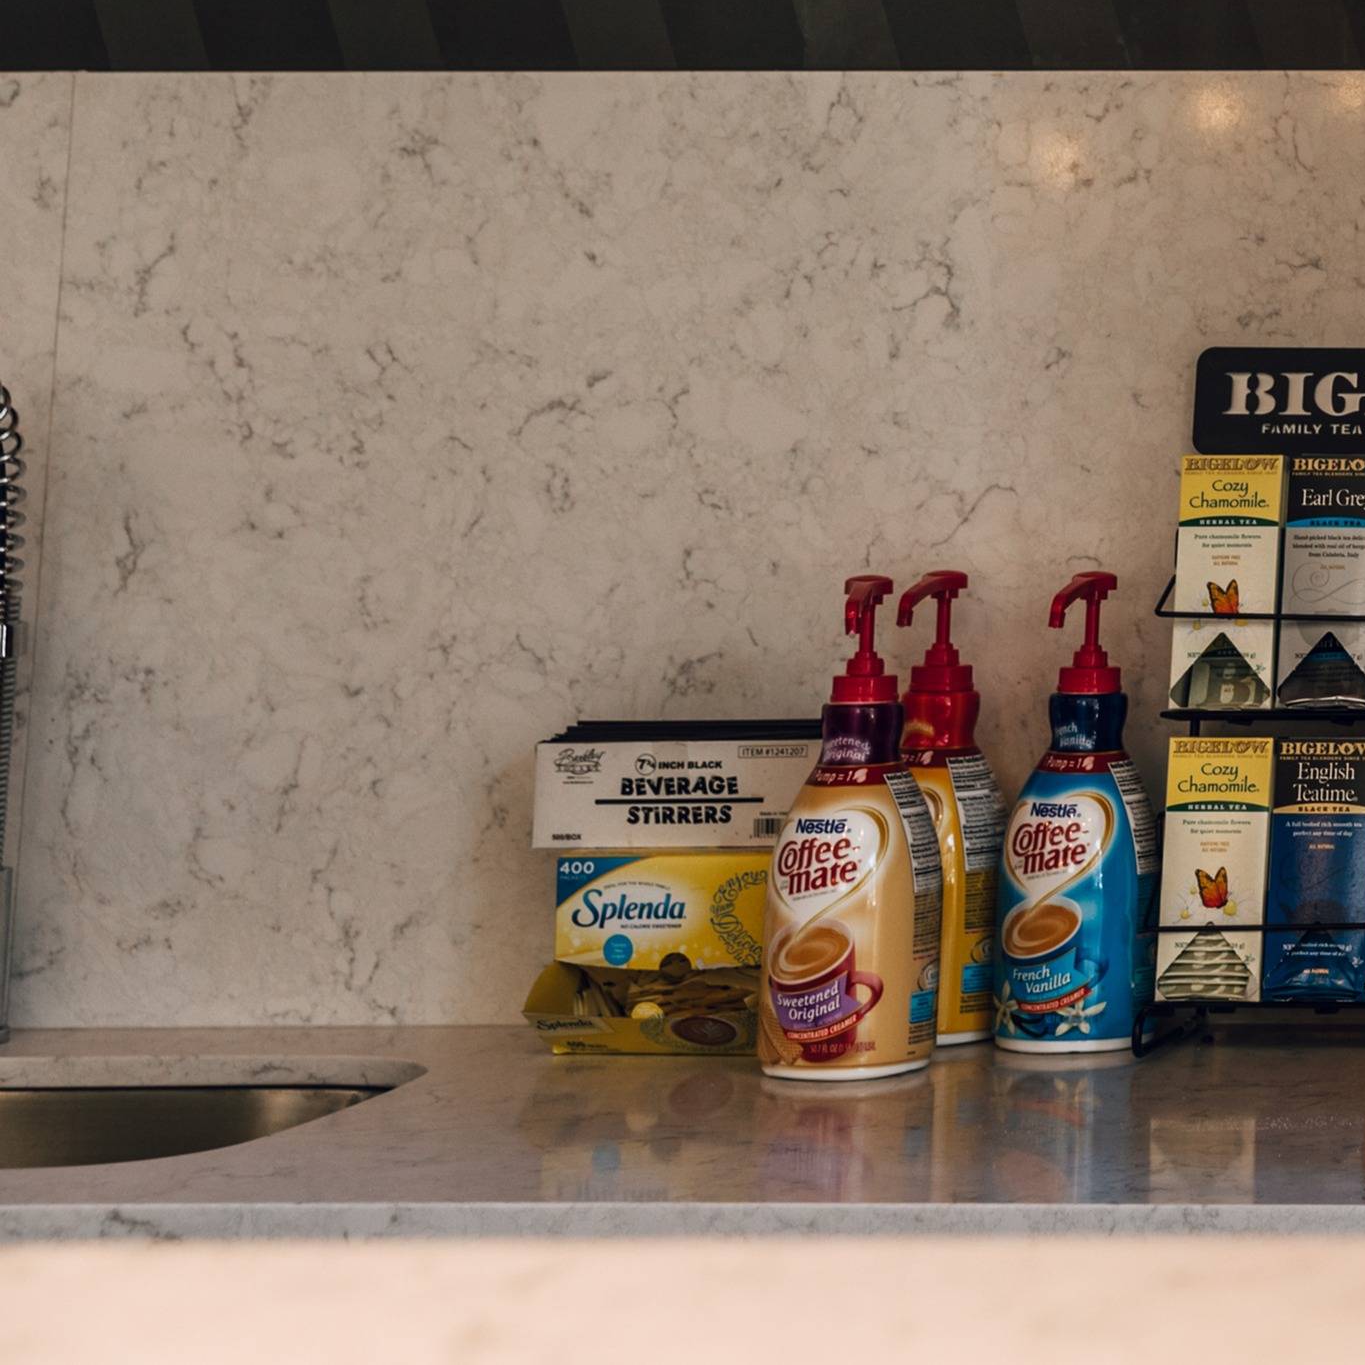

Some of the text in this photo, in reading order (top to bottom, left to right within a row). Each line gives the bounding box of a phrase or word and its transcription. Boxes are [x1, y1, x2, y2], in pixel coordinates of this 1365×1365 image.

[1261, 423, 1322, 434] FAMILY
[1330, 423, 1362, 435] TEA
[1185, 458, 1279, 471] BIGELOW
[1212, 479, 1249, 498] Cozy
[1301, 488, 1333, 506] Earl
[742, 747, 805, 756] ITEM #1241207
[1173, 740, 1269, 754] BIGELOW
[658, 761, 684, 770] INCH
[687, 761, 722, 769] BLACK
[1201, 763, 1239, 782] Cozy
[1297, 762, 1355, 784] English
[621, 776, 739, 796] BEVERAGE
[1292, 783, 1355, 802] Teatime
[560, 861, 595, 874] 400
[1023, 844, 1086, 874] mate
[788, 860, 858, 895] mate
[572, 889, 685, 929] Splenda
[1013, 965, 1050, 981] French
[1025, 972, 1071, 993] Vanilla
[777, 980, 839, 1007] Sweetened
[788, 995, 840, 1022] Original
